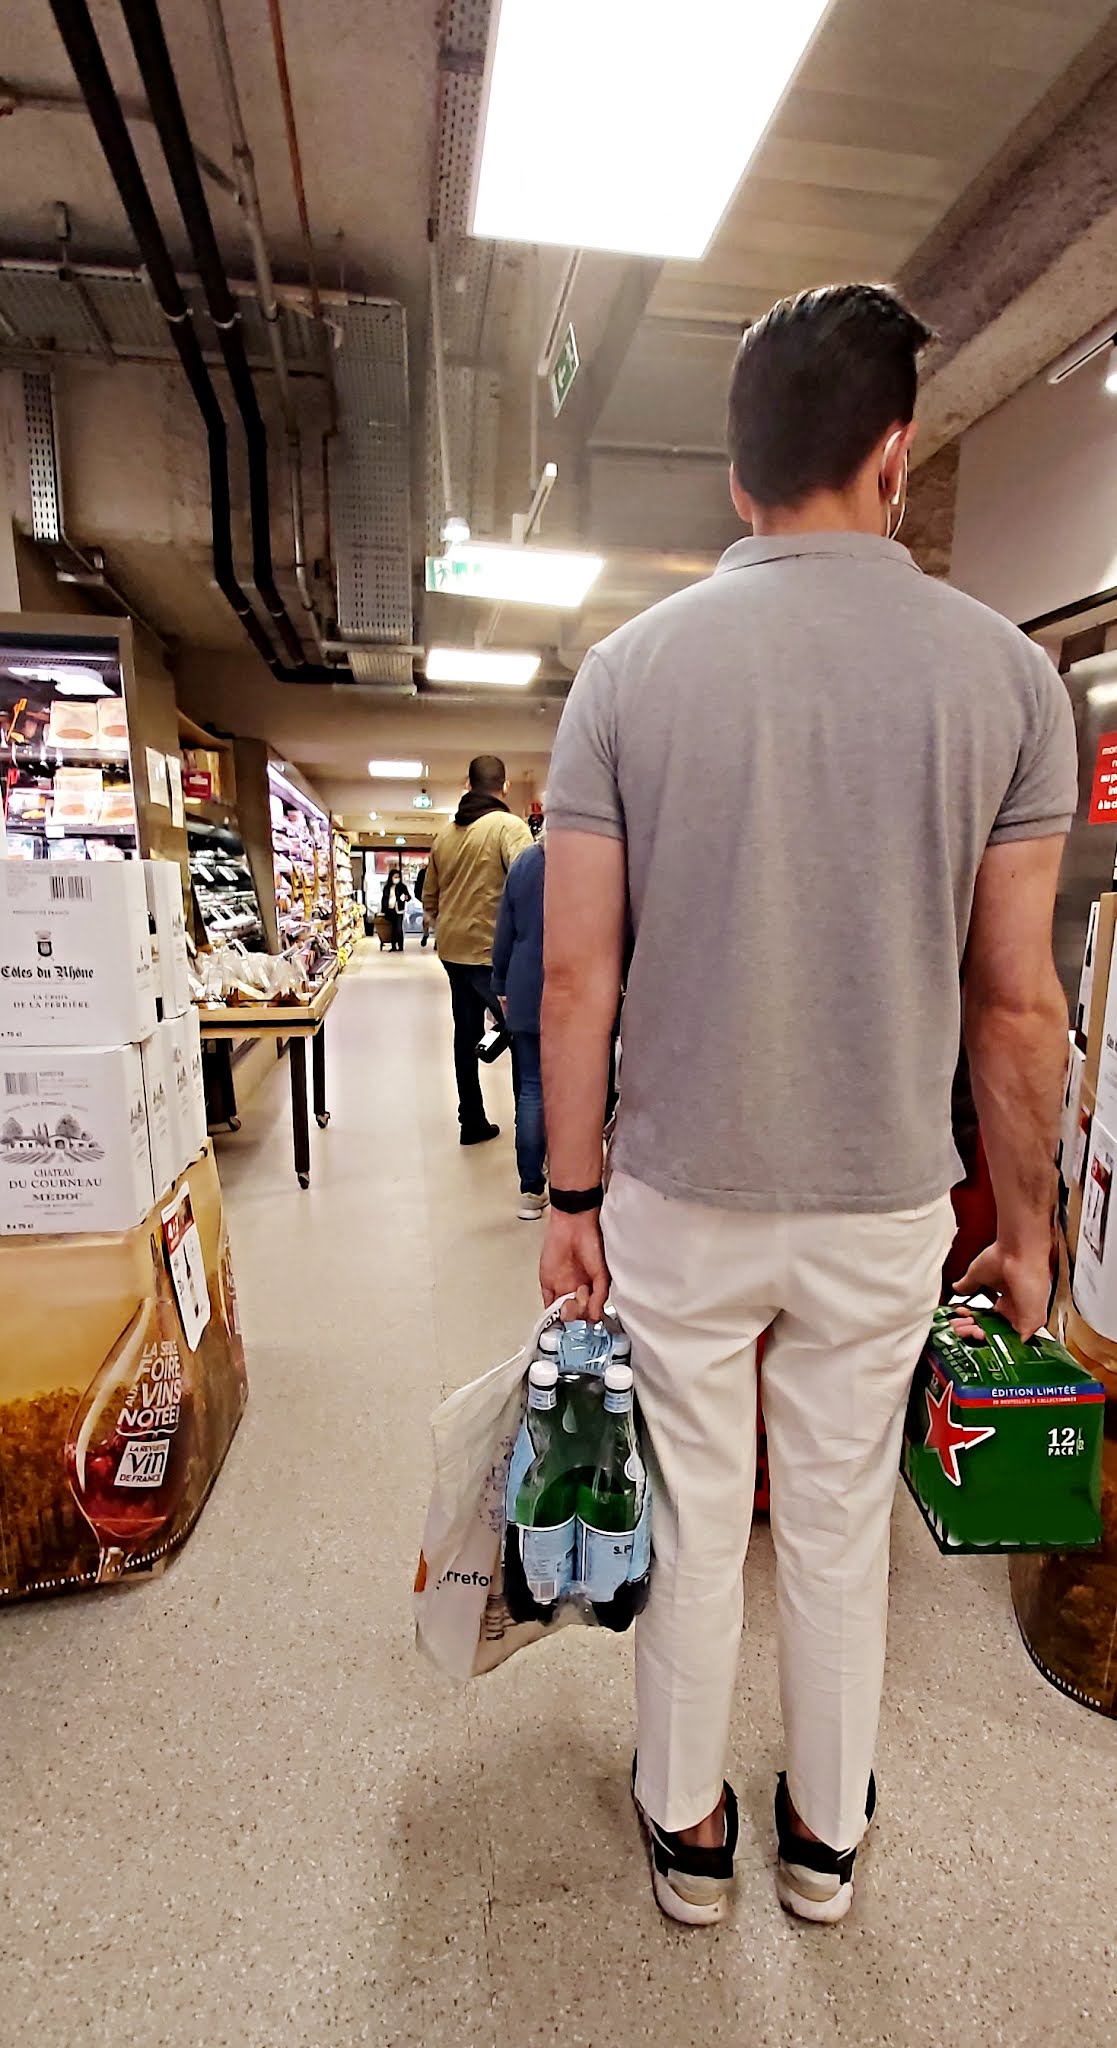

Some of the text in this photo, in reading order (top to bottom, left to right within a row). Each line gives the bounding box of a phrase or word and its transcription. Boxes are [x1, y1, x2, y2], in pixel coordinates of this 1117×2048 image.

[36, 966, 51, 979] du
[9, 1178, 102, 1188] DU COURNEAU
[142, 1342, 158, 1358] LA
[136, 1355, 181, 1382] FOIRE
[142, 1379, 182, 1408] VINS
[992, 1385, 1076, 1397] ÉDITION LIMITÉE
[1048, 1427, 1076, 1446] 12
[1048, 1447, 1074, 1456] PACK
